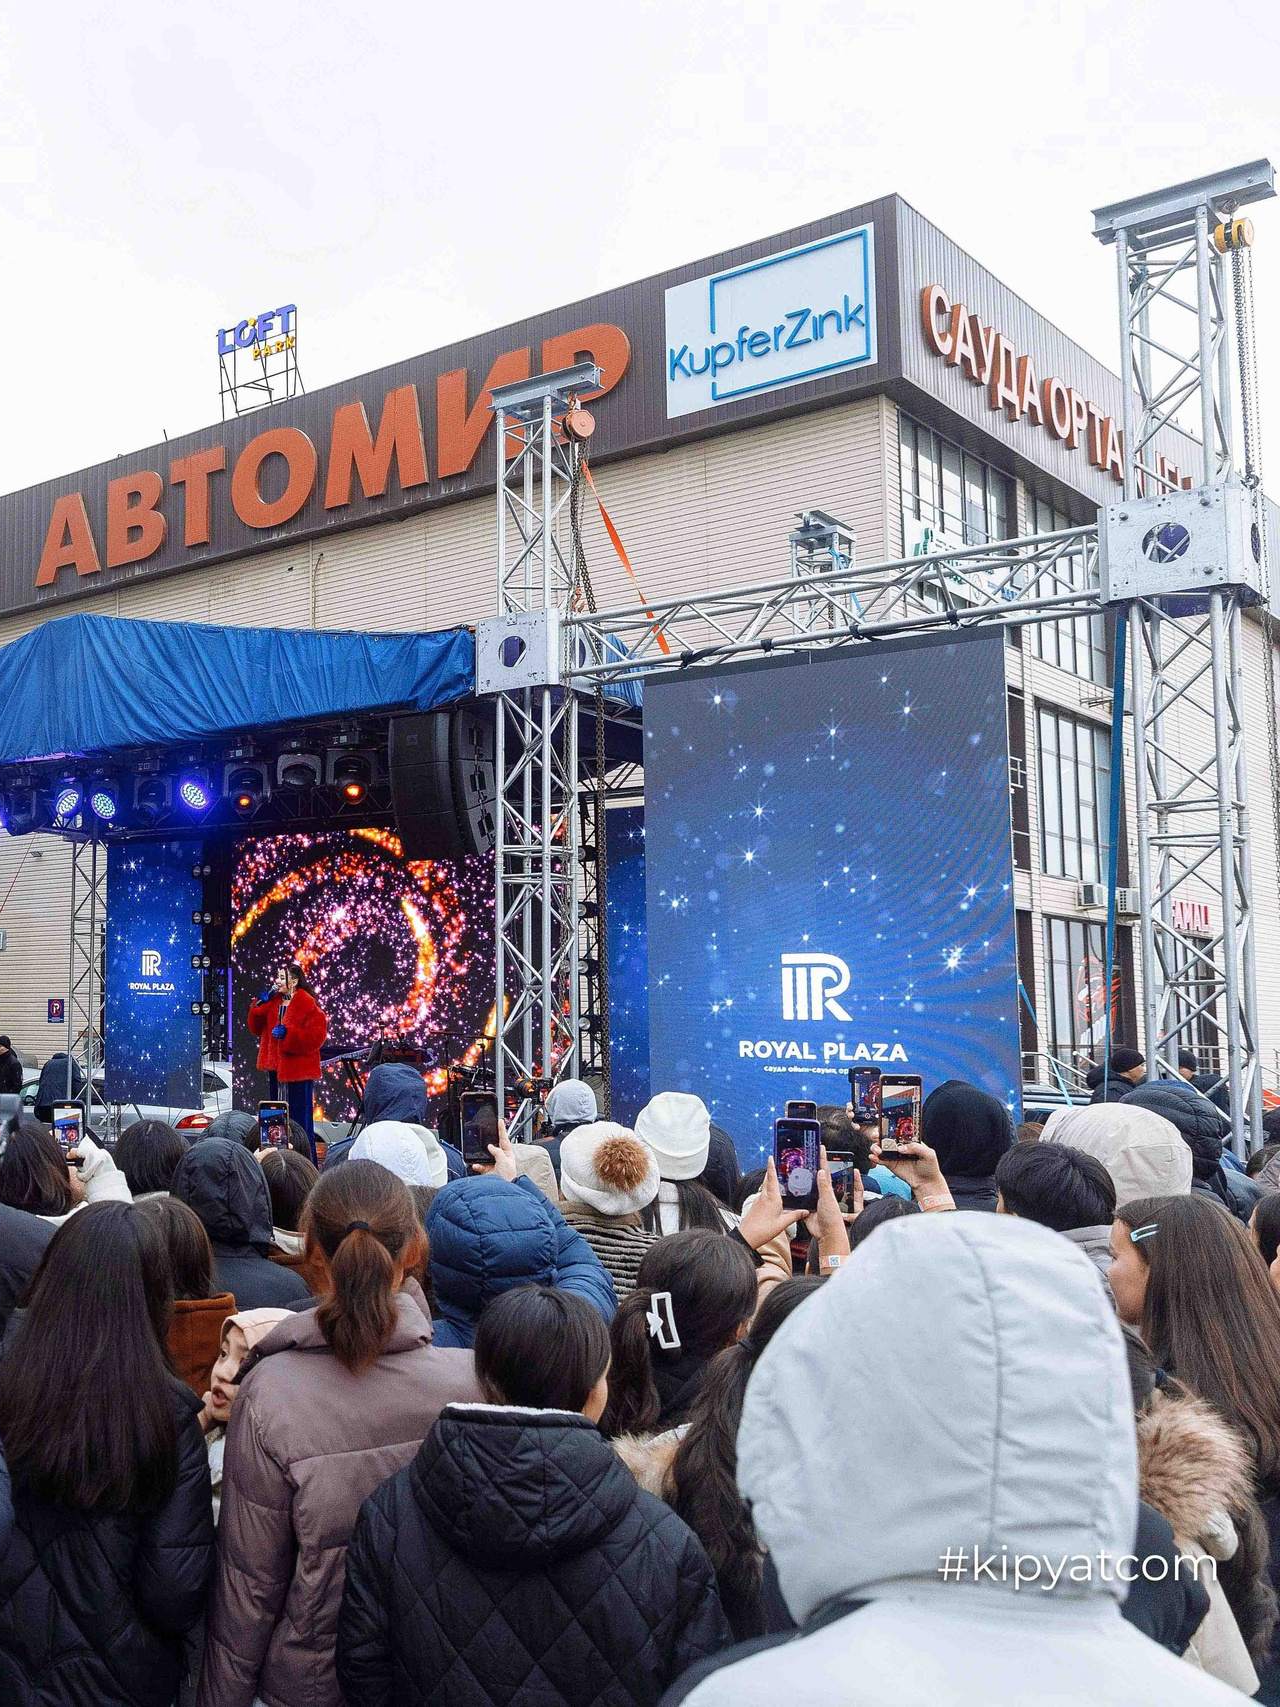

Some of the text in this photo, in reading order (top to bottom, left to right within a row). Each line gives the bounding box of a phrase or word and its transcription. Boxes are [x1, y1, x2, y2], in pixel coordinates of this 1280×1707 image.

[218, 304, 296, 355] LOFT
[253, 336, 296, 361] PARK
[923, 284, 1043, 426] САУДА
[35, 322, 632, 588] АВТОМИР
[738, 1040, 909, 1062] ROYAL PLAZA
